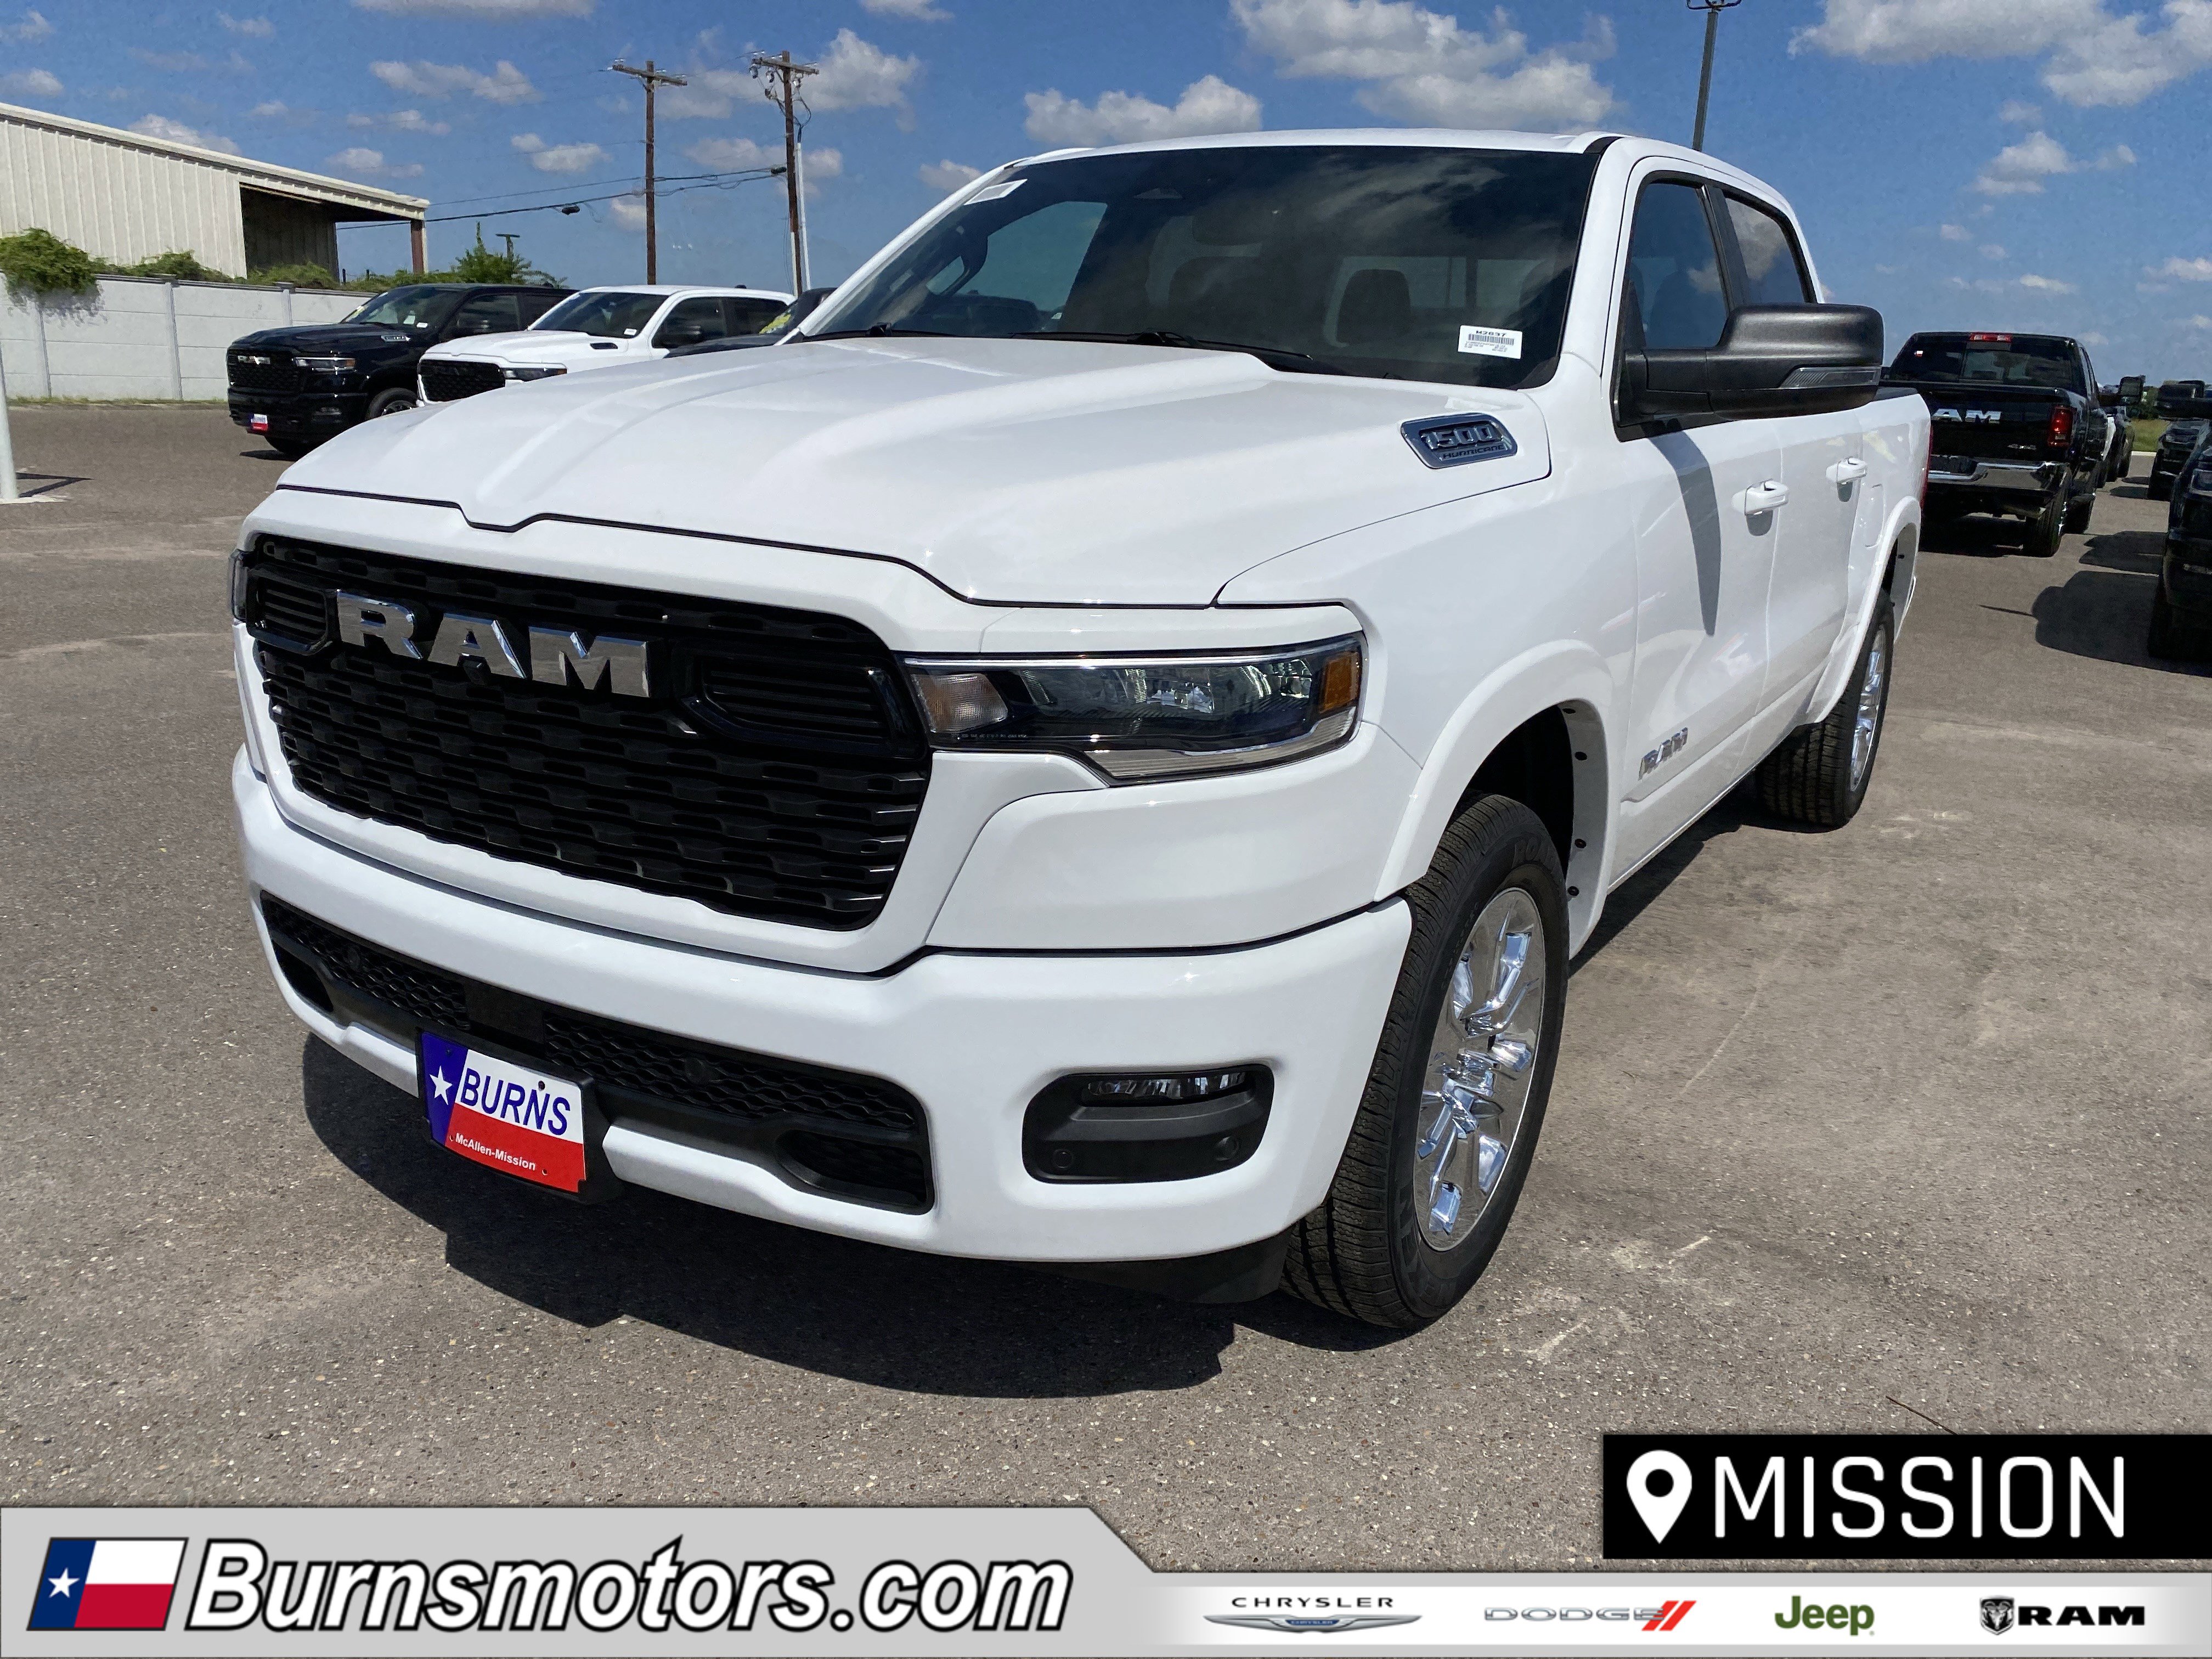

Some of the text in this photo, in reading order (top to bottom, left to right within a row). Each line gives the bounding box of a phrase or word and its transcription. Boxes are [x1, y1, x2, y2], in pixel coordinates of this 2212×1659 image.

[1931, 408, 2002, 424] AM
[1420, 421, 1504, 451] 1500
[1442, 444, 1506, 459] HURRICANE
[336, 590, 652, 698] RAM
[460, 1068, 571, 1136] BURNS
[455, 1132, 536, 1171] McAllen-Mission
